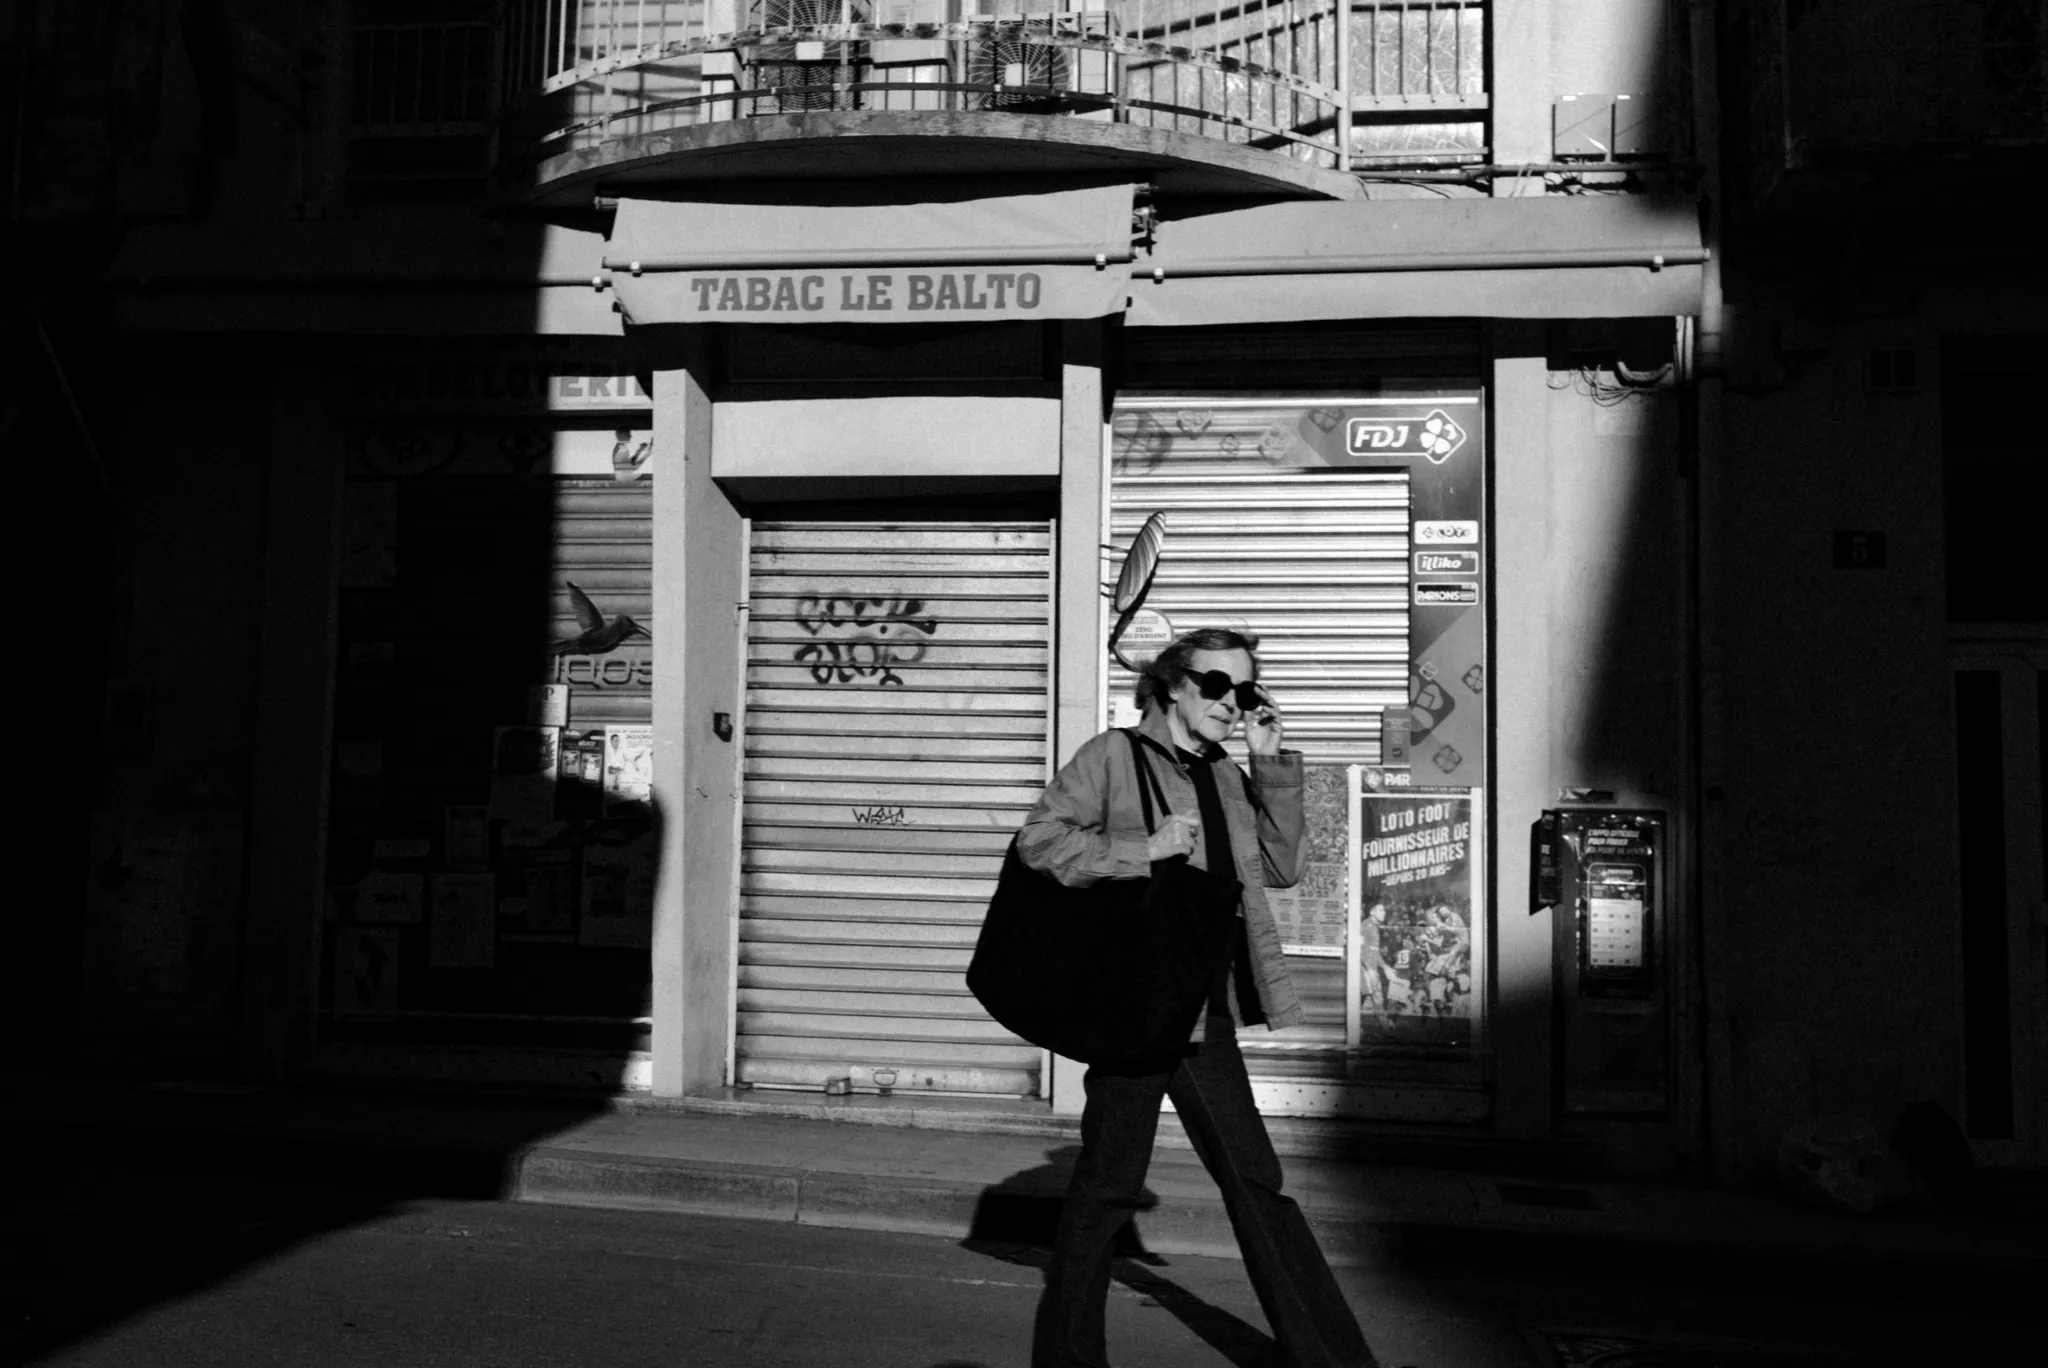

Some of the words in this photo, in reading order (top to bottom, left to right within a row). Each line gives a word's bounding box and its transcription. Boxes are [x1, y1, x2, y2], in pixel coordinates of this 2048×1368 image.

[691, 276, 825, 312] TABAC
[840, 275, 893, 311] LE
[907, 272, 1041, 311] BALTO
[1353, 425, 1410, 449] FDJ
[1851, 535, 1869, 563] 5
[1380, 809, 1415, 833] LOTO
[1417, 802, 1451, 825] FOOT
[1362, 826, 1450, 860] FOURNISSEUR
[1453, 821, 1470, 841] DE
[1367, 842, 1466, 878] MILLIONNAIRES
